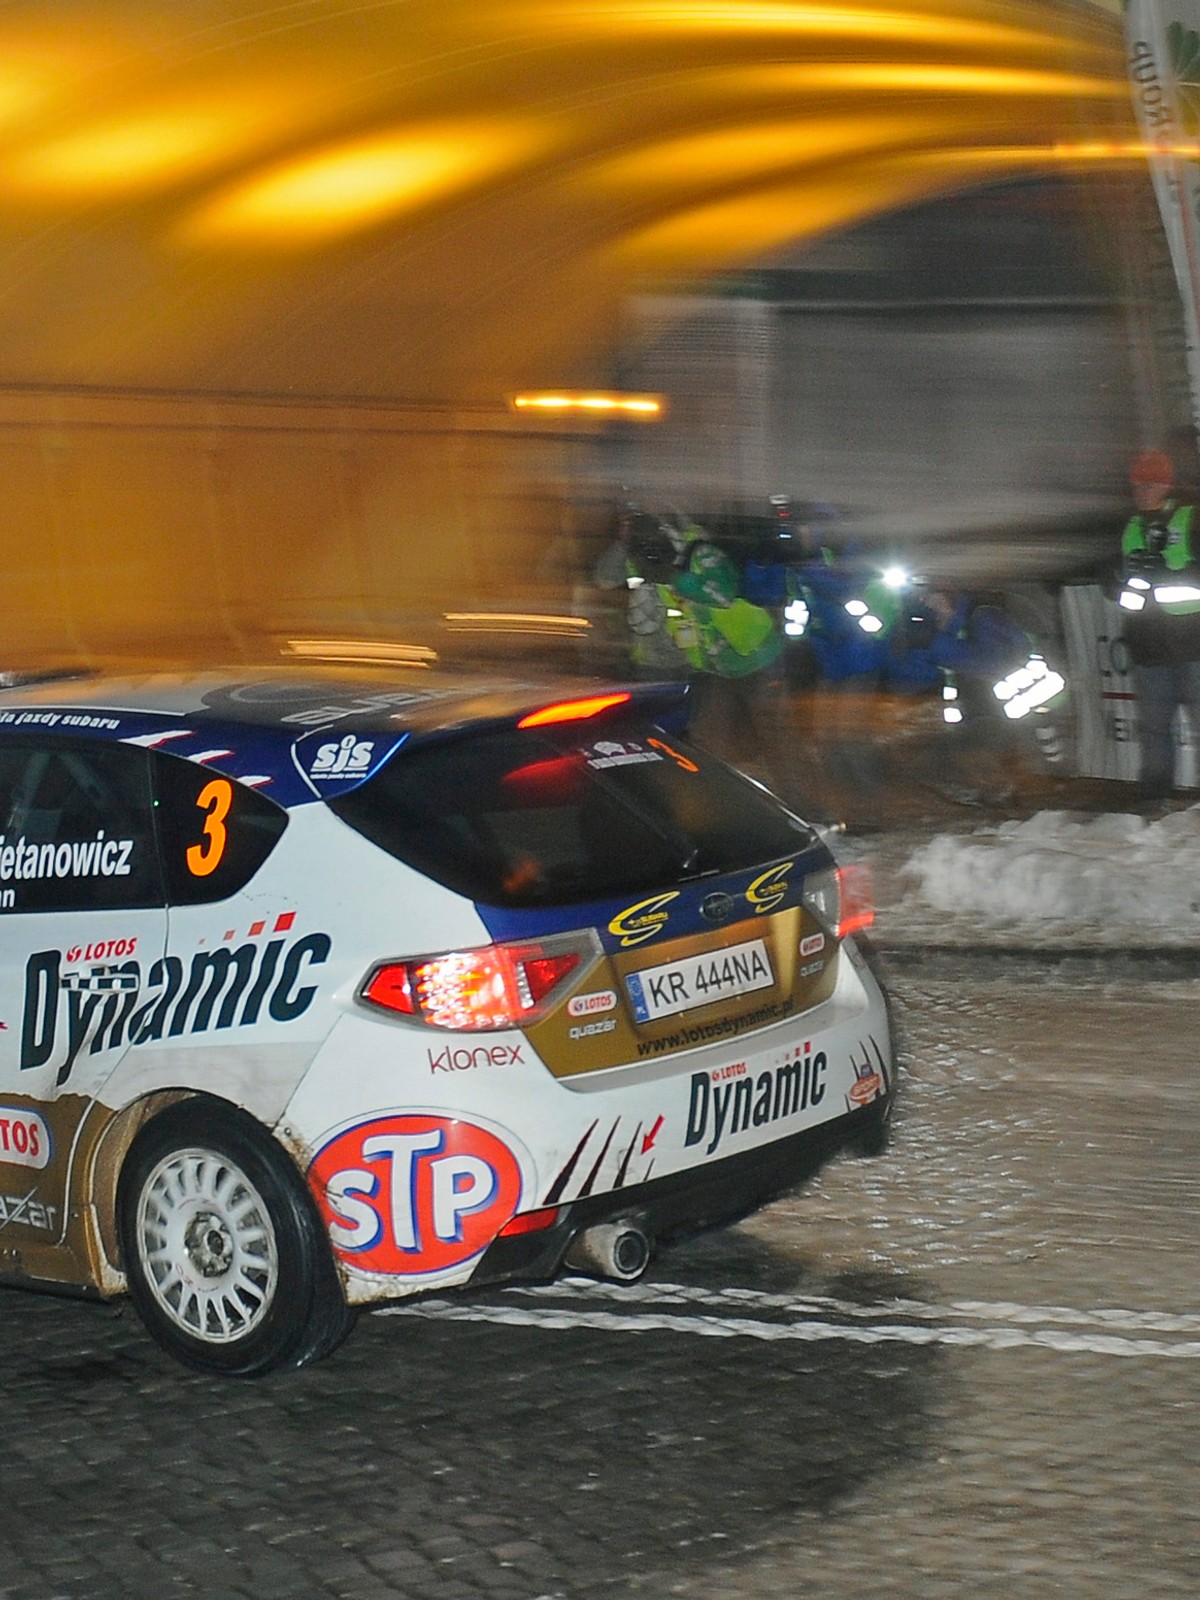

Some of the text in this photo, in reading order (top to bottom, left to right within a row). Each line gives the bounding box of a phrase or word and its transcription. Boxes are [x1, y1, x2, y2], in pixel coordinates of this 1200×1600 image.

[14, 712, 62, 727] jazdy
[61, 714, 120, 730] subaru
[186, 779, 233, 876] 3
[84, 937, 138, 962] LOTOS
[584, 993, 613, 1011] LOTOS
[648, 950, 768, 1008] KR 444NA
[20, 932, 332, 1087] Dynamic
[637, 999, 795, 1056] www.lotosdynamic.pl
[427, 1043, 525, 1074] klonex
[721, 1061, 747, 1080] LOTOS
[684, 1051, 827, 1156] Dynamic
[327, 1128, 498, 1253] STP
